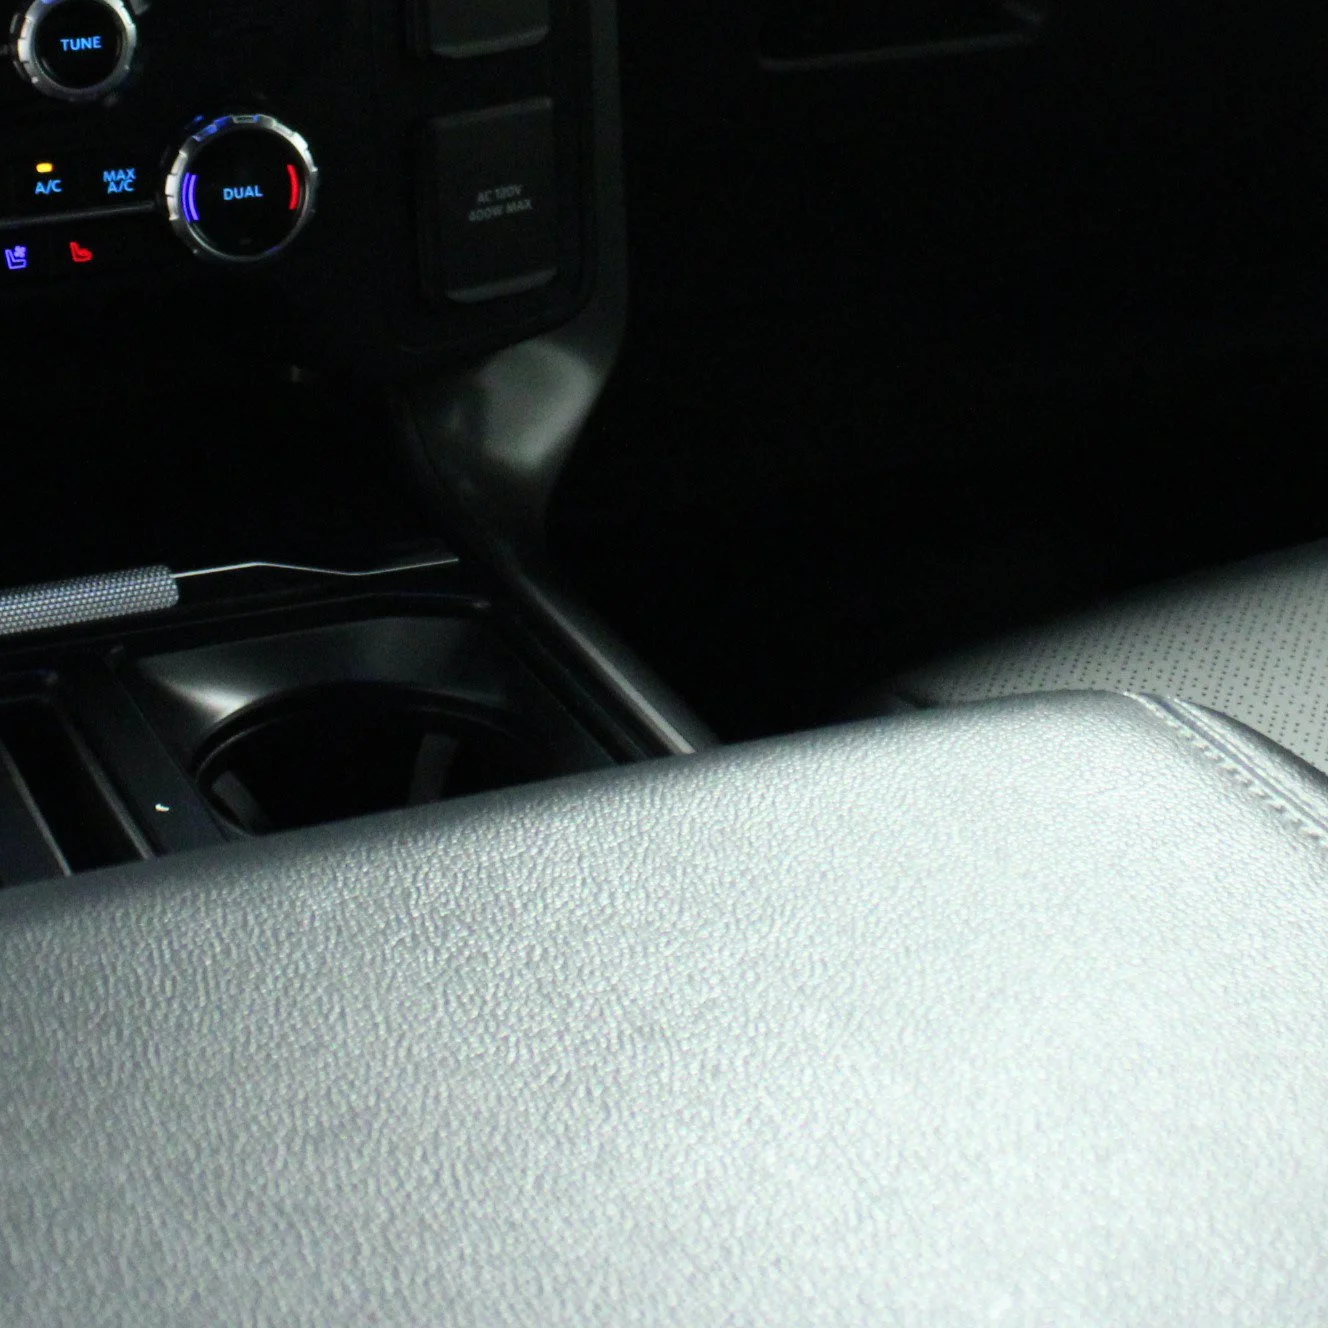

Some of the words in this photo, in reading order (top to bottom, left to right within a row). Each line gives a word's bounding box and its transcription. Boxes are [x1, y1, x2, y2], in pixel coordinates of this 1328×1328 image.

[59, 34, 103, 52] TUNE
[103, 168, 135, 183] MAX
[35, 179, 62, 195] A/C
[107, 179, 134, 194] A/C
[222, 184, 264, 201] DUAL
